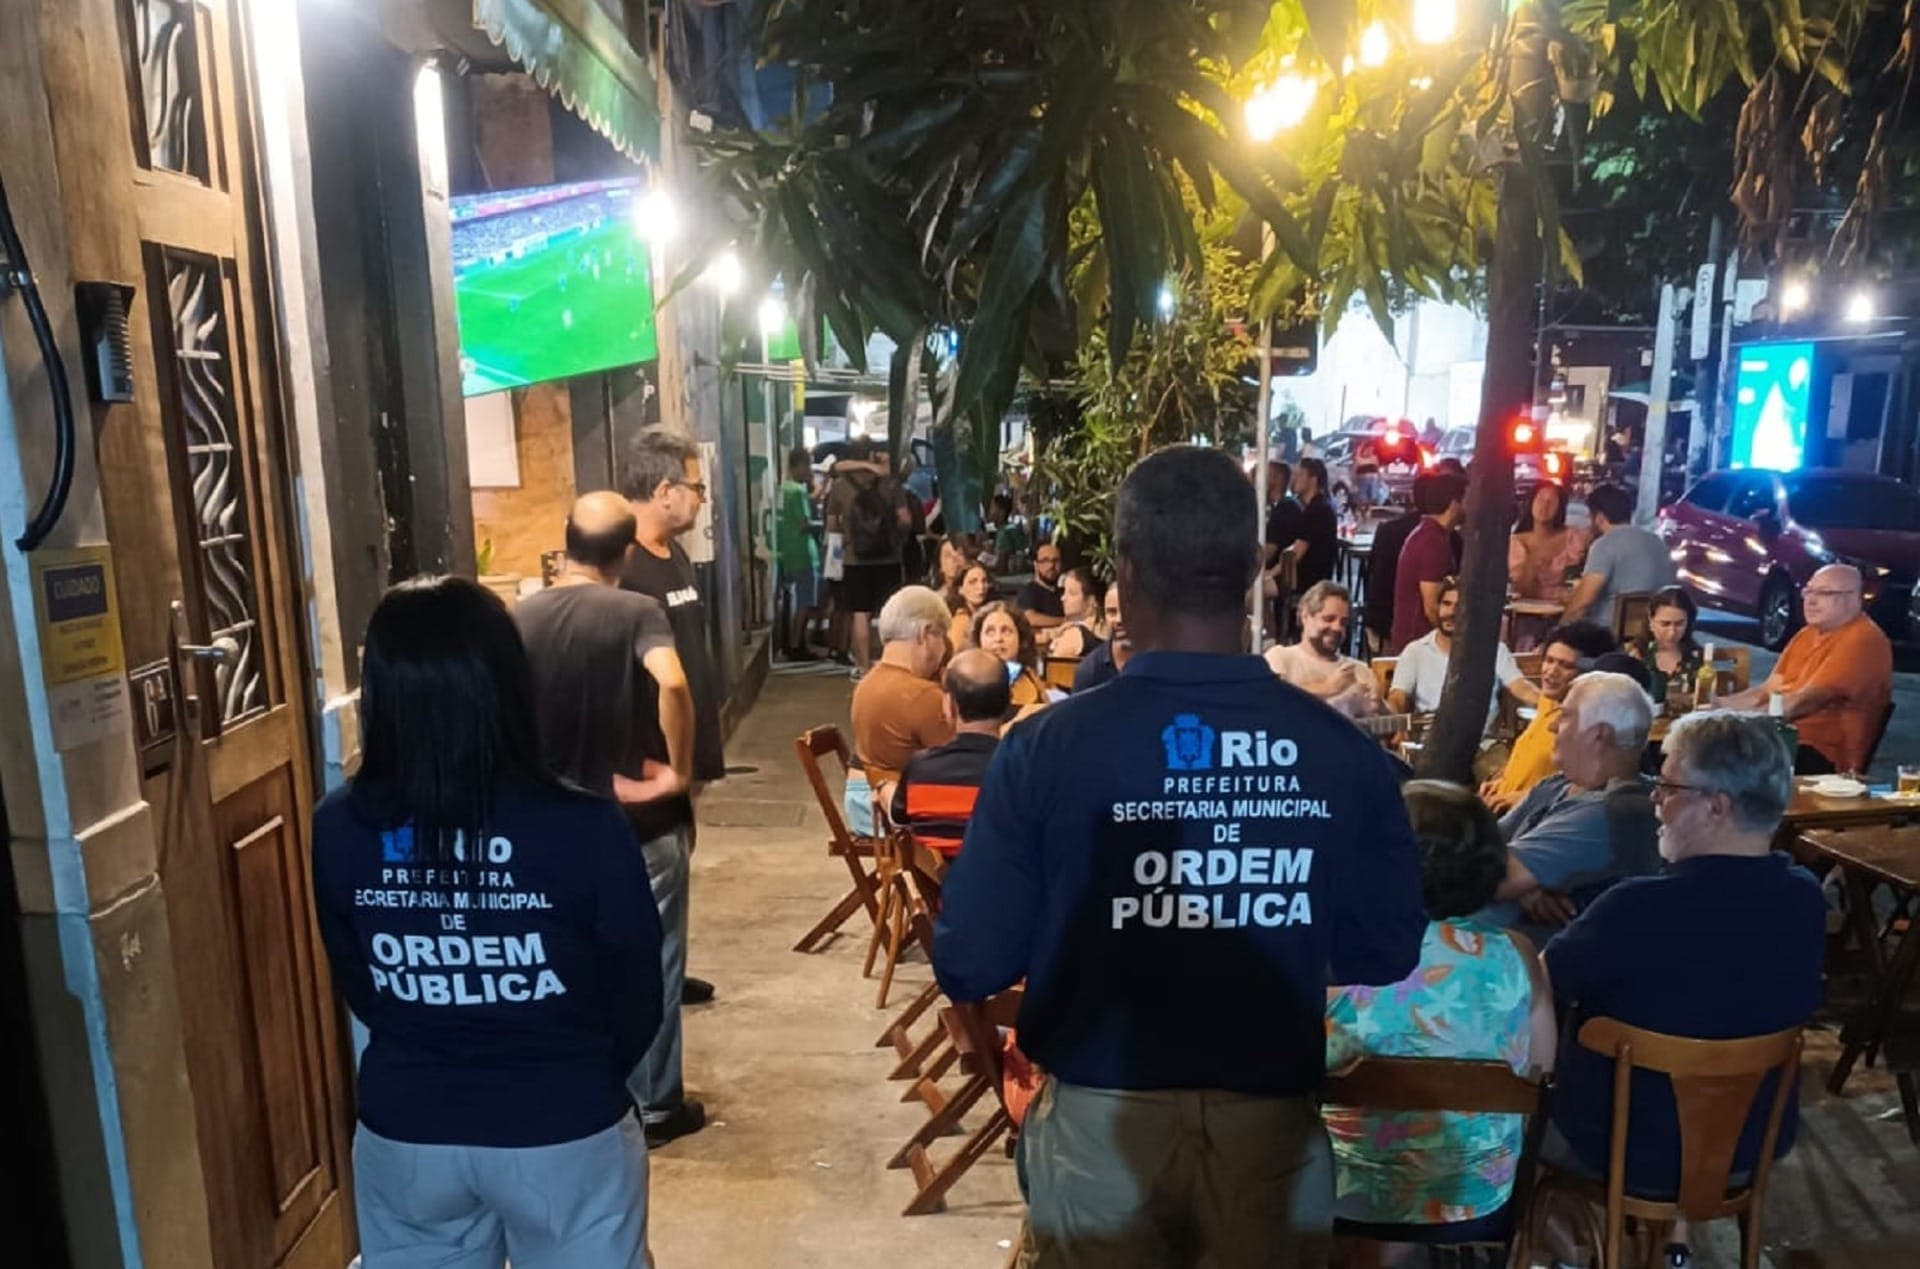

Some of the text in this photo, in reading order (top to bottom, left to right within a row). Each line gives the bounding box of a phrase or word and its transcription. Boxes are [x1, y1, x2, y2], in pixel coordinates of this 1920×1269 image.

[1220, 730, 1299, 768] Rio
[1163, 775, 1301, 794] PREFEITURA
[1112, 798, 1332, 823] SECRETARIA MUNICIPAL
[1213, 823, 1241, 843] DE
[1133, 847, 1314, 886] ORDEM
[440, 913, 467, 931] DE
[1112, 887, 1312, 930] PÚBLICA
[371, 932, 547, 967] ORDEM
[369, 965, 568, 1005] PÚBLICA
